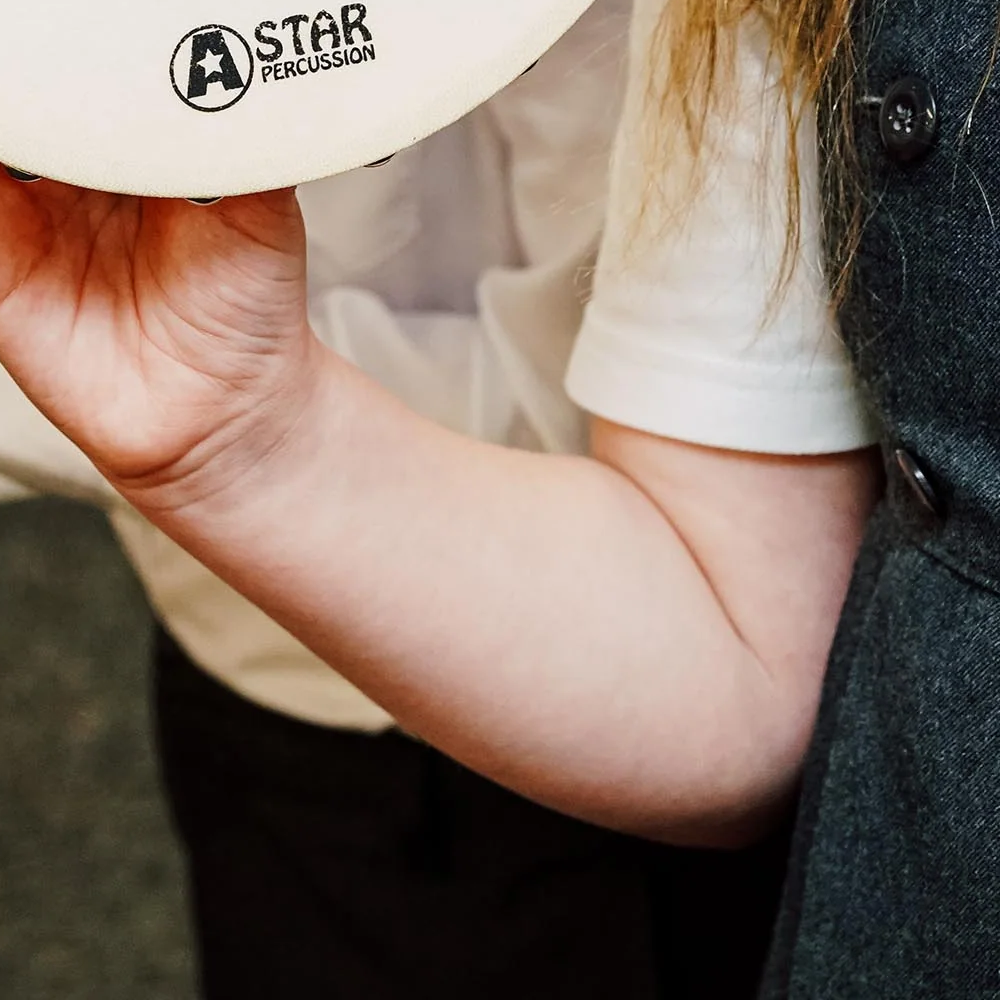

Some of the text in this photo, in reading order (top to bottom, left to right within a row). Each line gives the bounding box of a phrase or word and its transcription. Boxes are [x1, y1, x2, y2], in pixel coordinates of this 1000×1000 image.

[187, 3, 373, 99] A STAR
[261, 44, 376, 83] PERCUSSION
